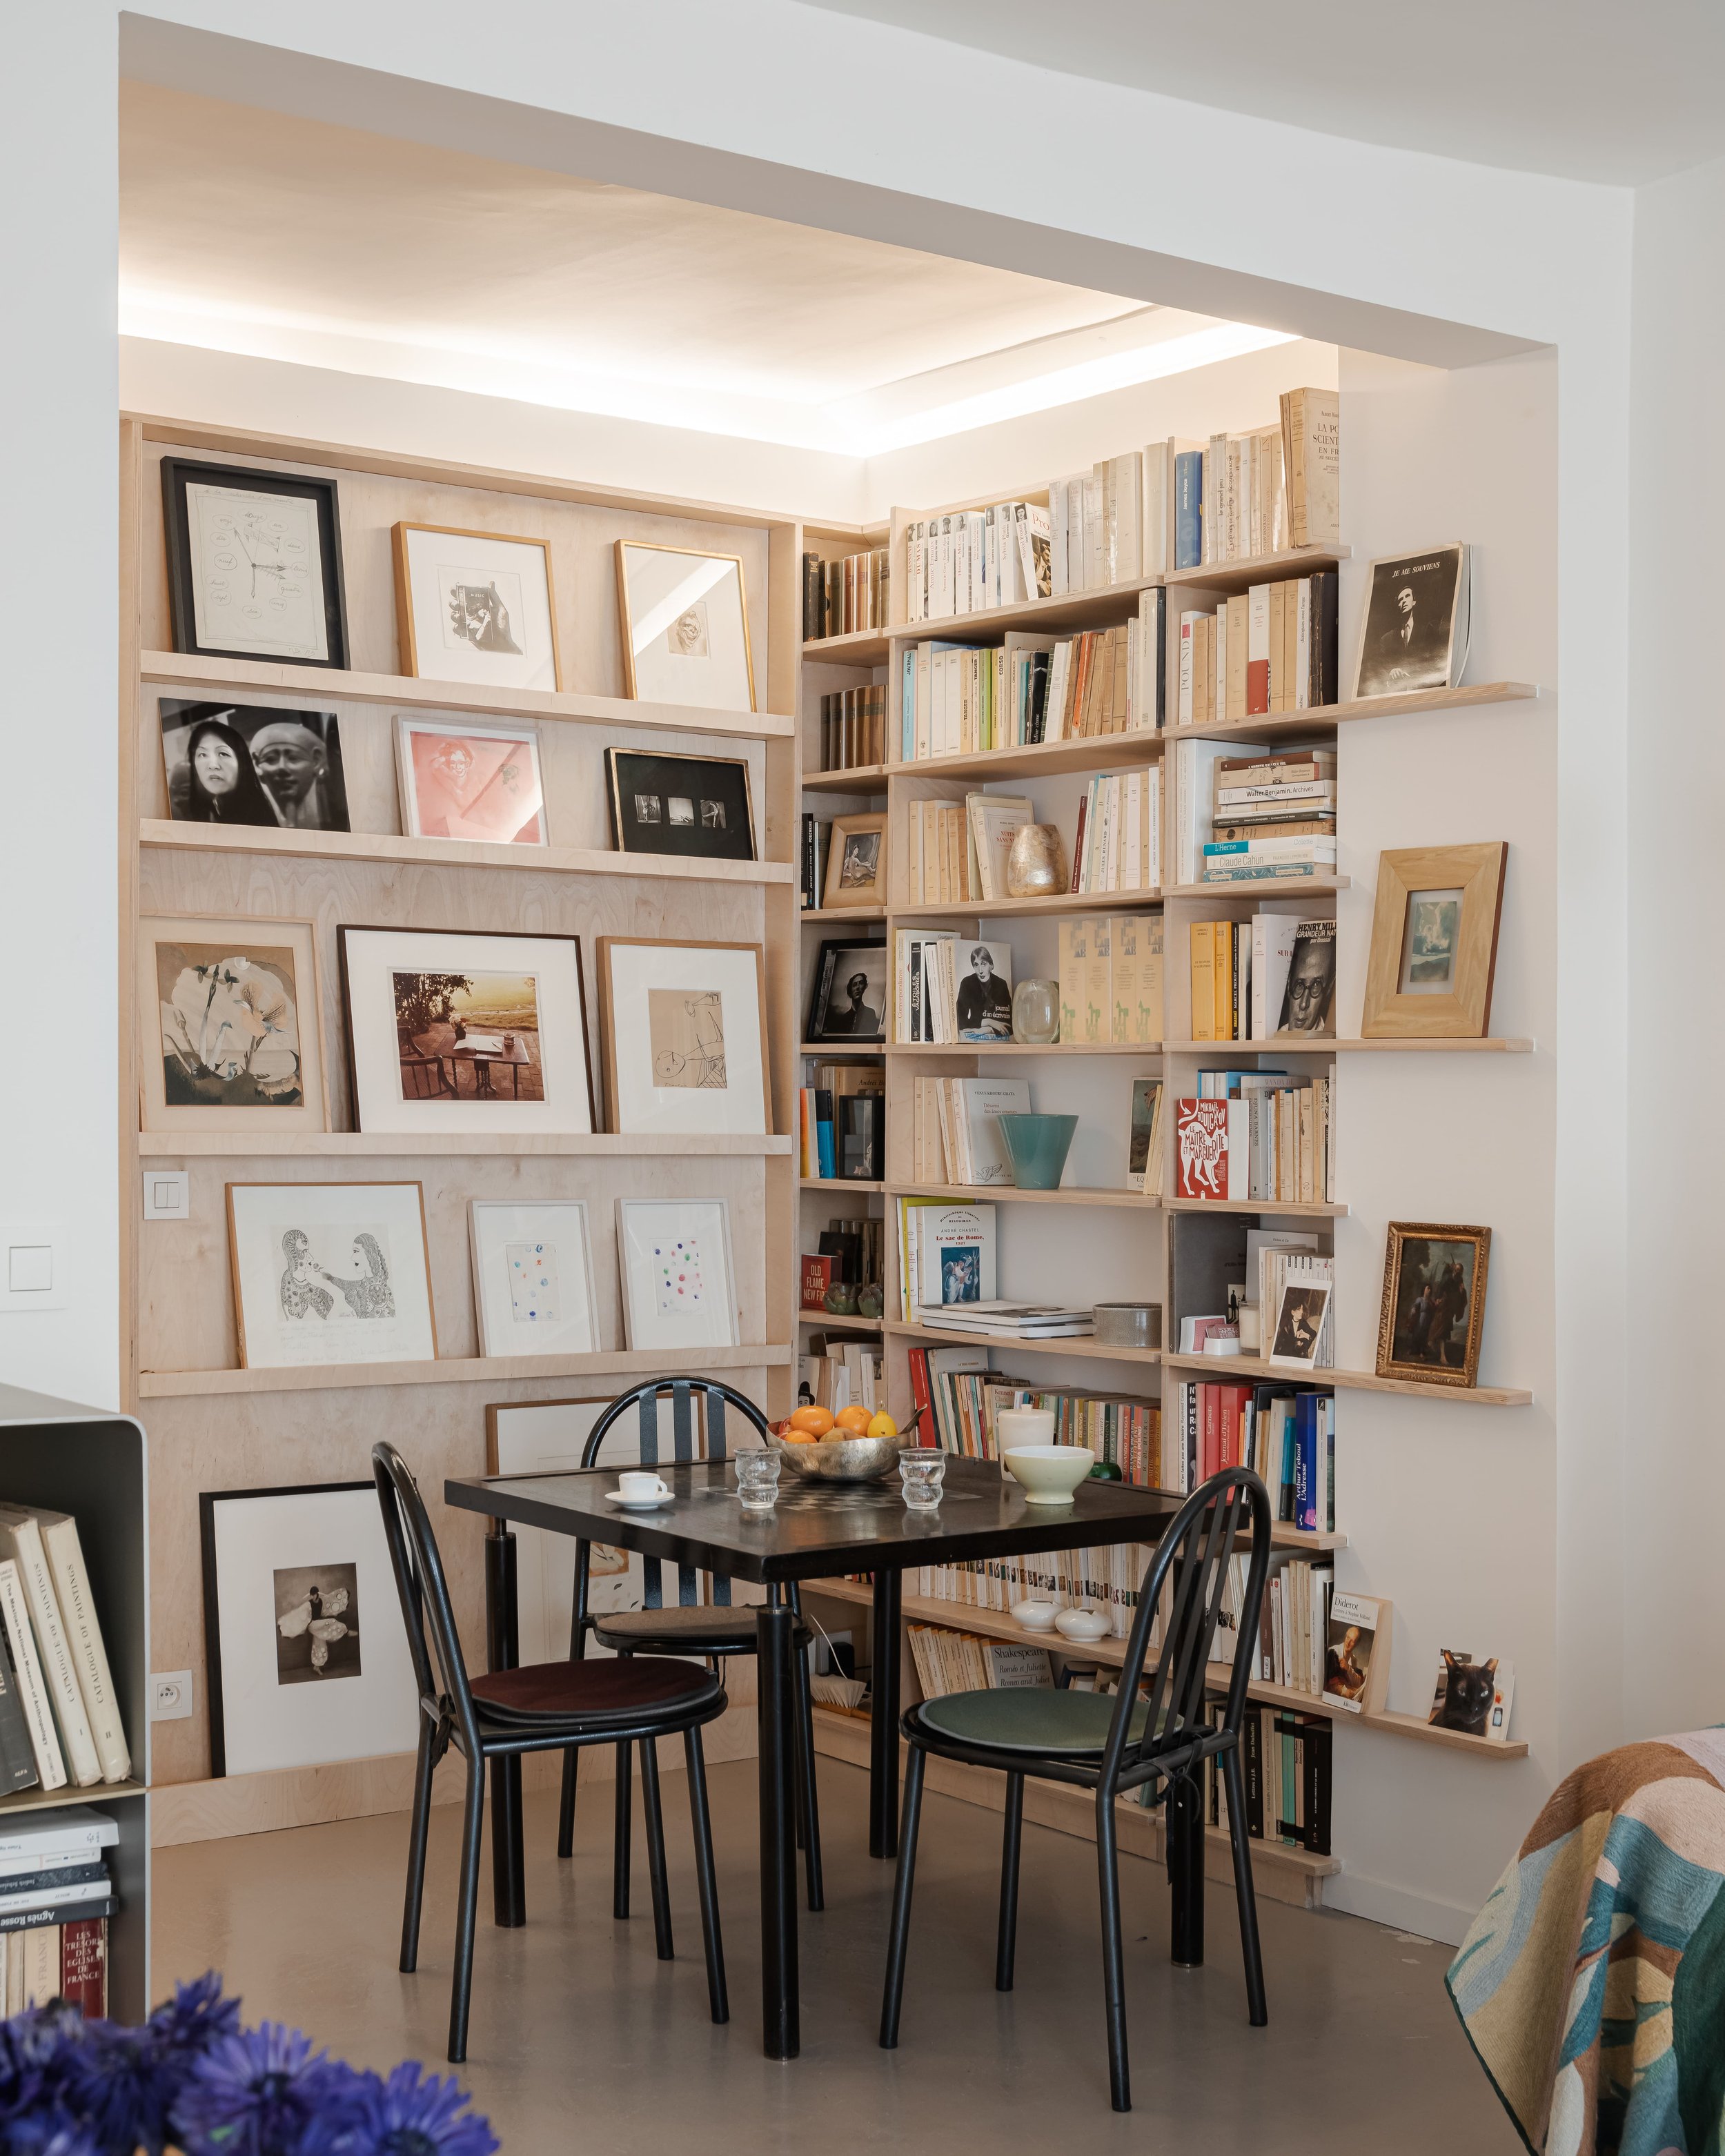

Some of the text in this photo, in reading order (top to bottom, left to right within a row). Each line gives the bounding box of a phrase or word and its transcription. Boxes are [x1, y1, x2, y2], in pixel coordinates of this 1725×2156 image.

[1317, 422, 1328, 432] LA
[1217, 490, 1225, 509] grand
[244, 512, 264, 522] douze
[217, 556, 233, 567] neuf
[1392, 570, 1399, 578] JE
[1412, 562, 1441, 574] SOUVIENS
[1181, 640, 1190, 691] POUND
[1246, 785, 1314, 799] Walter Benjamin. Archives
[1214, 838, 1314, 851] L'Herne Colette
[1219, 854, 1264, 868] Claude Cahun
[1299, 923, 1321, 931] HENRY
[1296, 930, 1326, 938] GRANDEUR
[995, 1004, 1010, 1012] journal
[1200, 1101, 1219, 1112] MIKHAÏL
[1197, 1108, 1225, 1132] BOULGAKOV
[1190, 1125, 1195, 1134] LE
[1183, 1147, 1188, 1155] ET
[939, 1210, 964, 1223] Bibliothèque
[810, 1264, 822, 1276] OLD
[806, 1276, 825, 1292] FLAME,
[803, 1288, 816, 1300] NEW
[994, 1388, 1014, 1396] Kenneth
[1334, 1596, 1359, 1611] Diderot
[9, 1598, 21, 1628] Mexican
[1348, 1610, 1359, 1619] Sophie
[34, 1563, 75, 1703] CATALOGUE OF PAINTINGS
[66, 1563, 103, 1704] CATALOGUE OF PAINTINGS
[16, 1628, 28, 1660] National
[994, 1647, 1045, 1660] Shakespeare
[999, 1664, 1018, 1673] Roméo
[1026, 1663, 1047, 1672] Juliette
[23, 1660, 34, 1689] Museum
[1000, 1676, 1050, 1688] Romeo and Juliet
[32, 1688, 37, 1699] of
[32, 1699, 48, 1747] Anthropology
[19, 1878, 35, 1886] Judith
[27, 1910, 55, 1923] Agnès
[76, 1930, 91, 1941] LES
[75, 1948, 92, 1957] DES
[37, 1931, 48, 2004] EN FRANCE
[77, 1964, 89, 1974] DE
[66, 1972, 100, 1984] FRANCE
